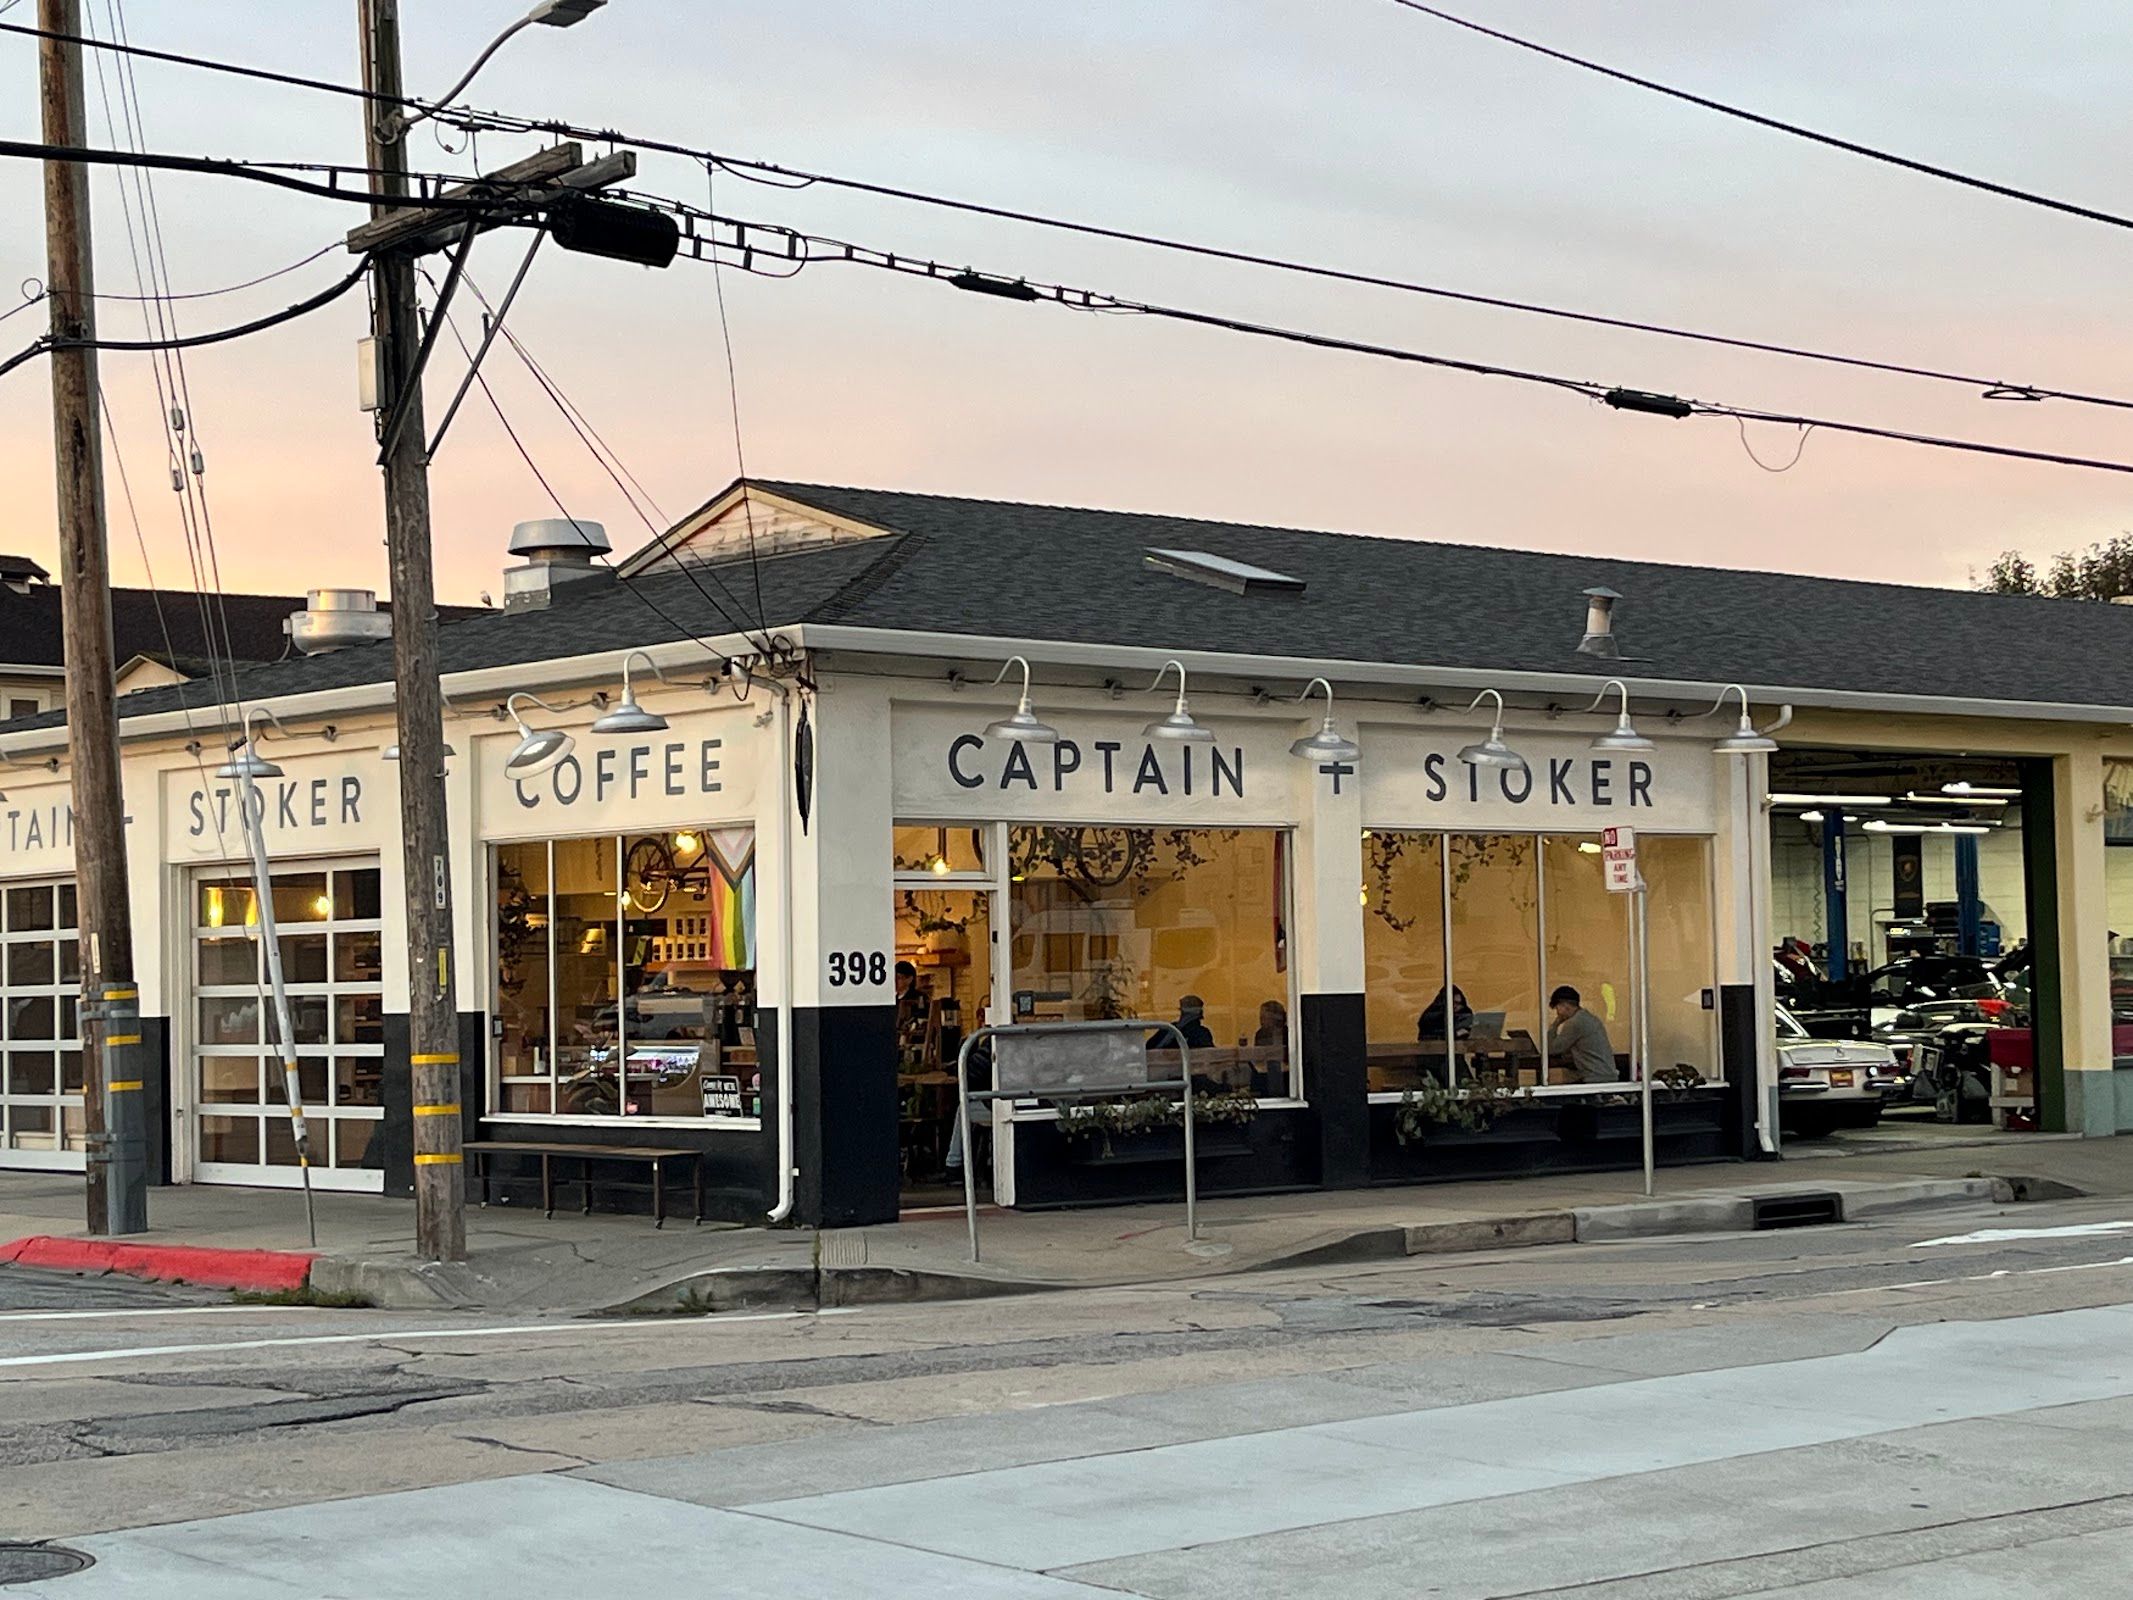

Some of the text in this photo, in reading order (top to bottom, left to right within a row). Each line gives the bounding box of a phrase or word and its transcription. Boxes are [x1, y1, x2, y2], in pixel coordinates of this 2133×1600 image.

[190, 776, 361, 835] STOKER
[515, 739, 722, 808] COFFEE
[948, 734, 1243, 797] CAPTAIN
[1424, 753, 1653, 806] STOKER
[1604, 830, 1616, 846] NO
[435, 859, 445, 904] 709
[1613, 863, 1627, 871] ANY
[828, 951, 887, 986] 398
